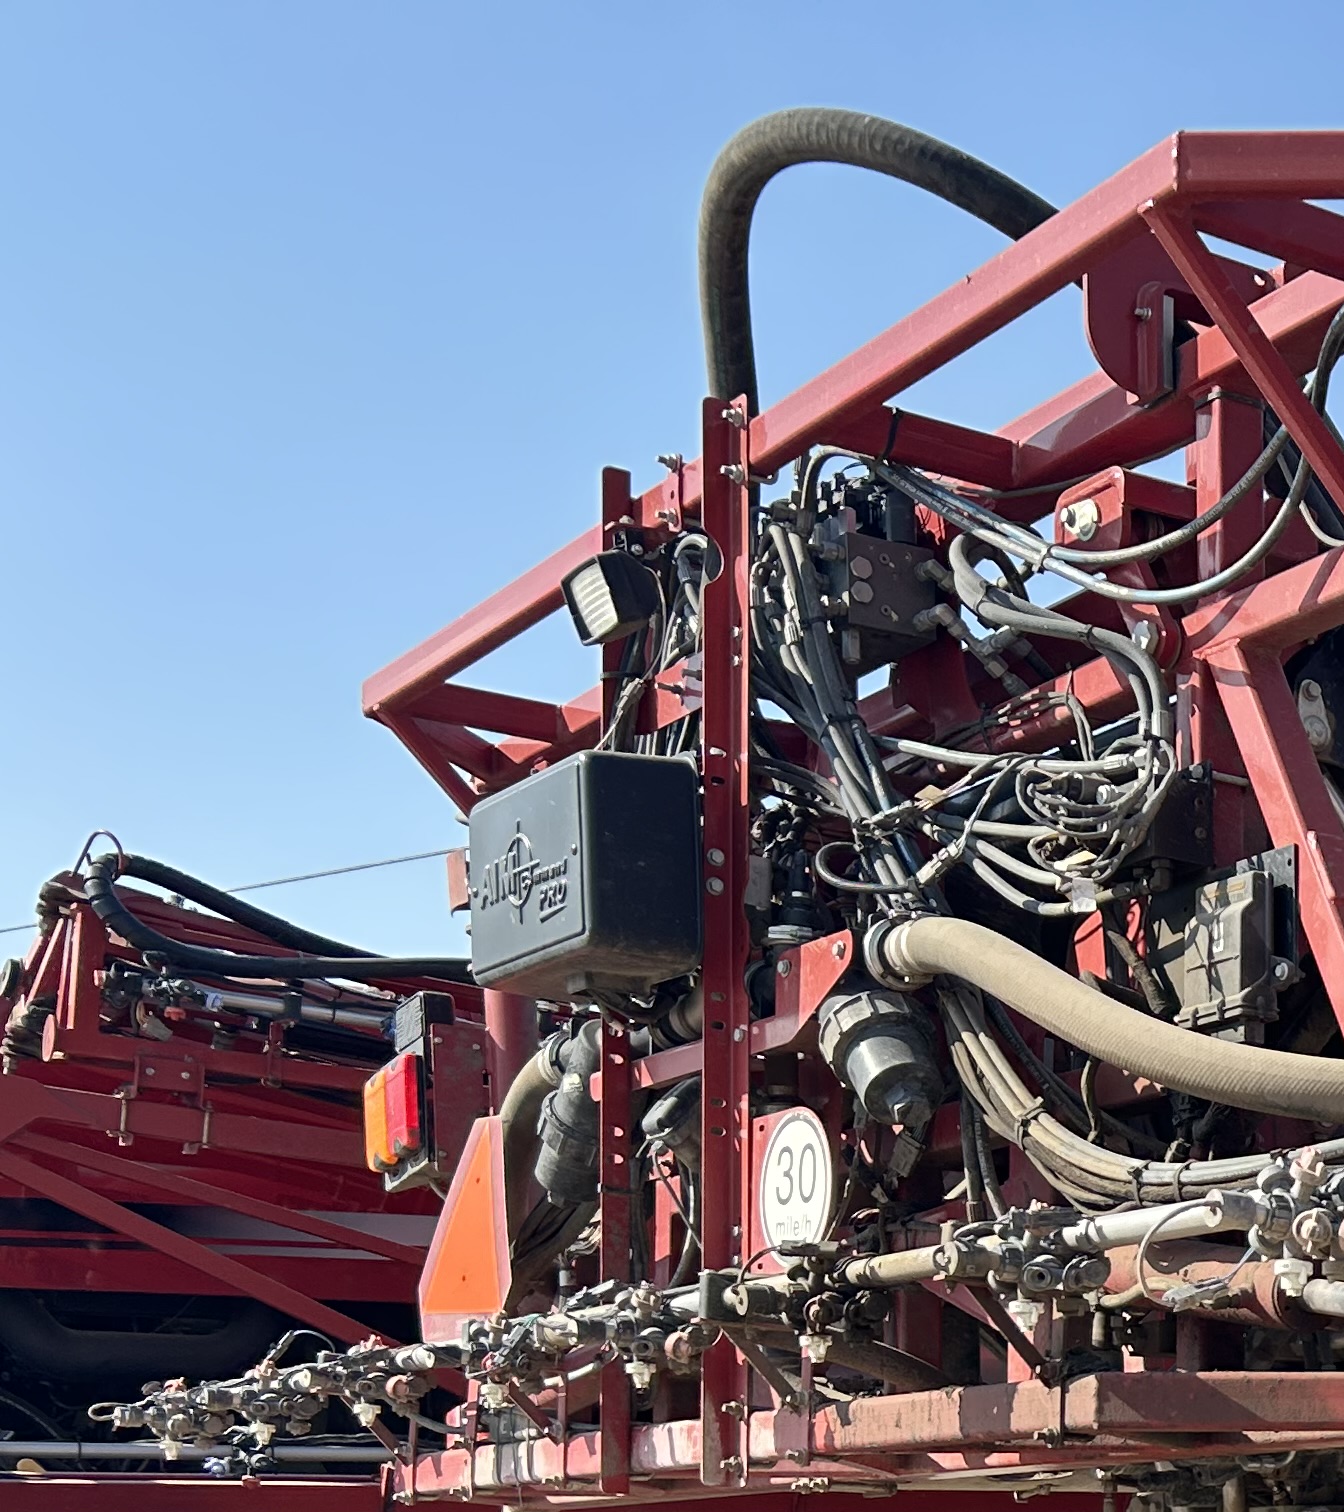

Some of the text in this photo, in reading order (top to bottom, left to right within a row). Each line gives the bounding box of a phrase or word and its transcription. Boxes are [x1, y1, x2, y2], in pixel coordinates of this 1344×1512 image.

[539, 878, 569, 912] PRO
[776, 1143, 816, 1206] 30
[775, 1213, 812, 1238] mile/h
